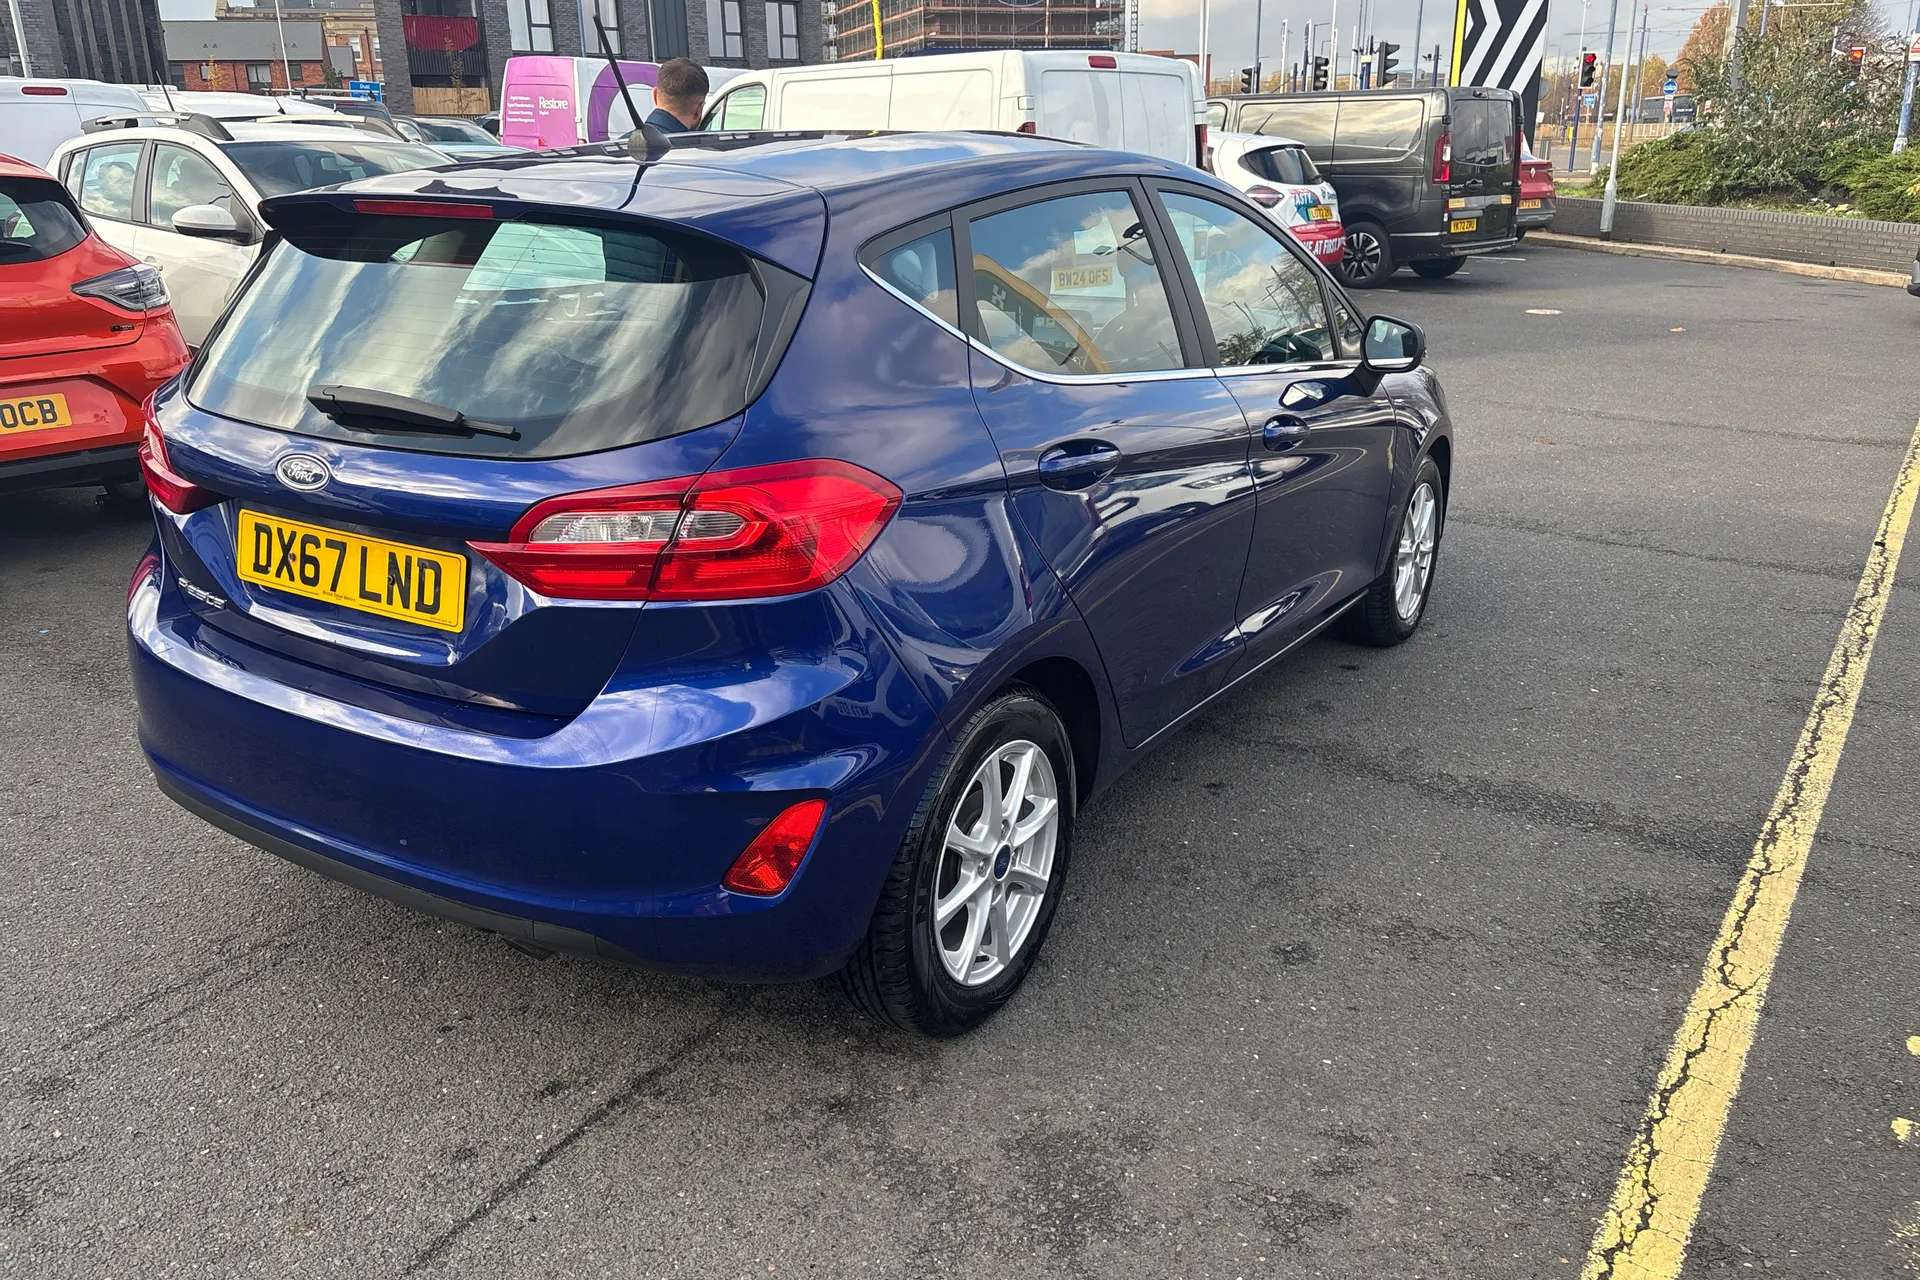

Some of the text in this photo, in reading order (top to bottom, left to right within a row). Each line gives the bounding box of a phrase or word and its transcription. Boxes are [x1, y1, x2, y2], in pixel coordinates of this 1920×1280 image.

[539, 96, 569, 109] Restore
[1088, 267, 1109, 284] OFS
[287, 461, 316, 483] Ford
[253, 522, 442, 616] DX67 LND
